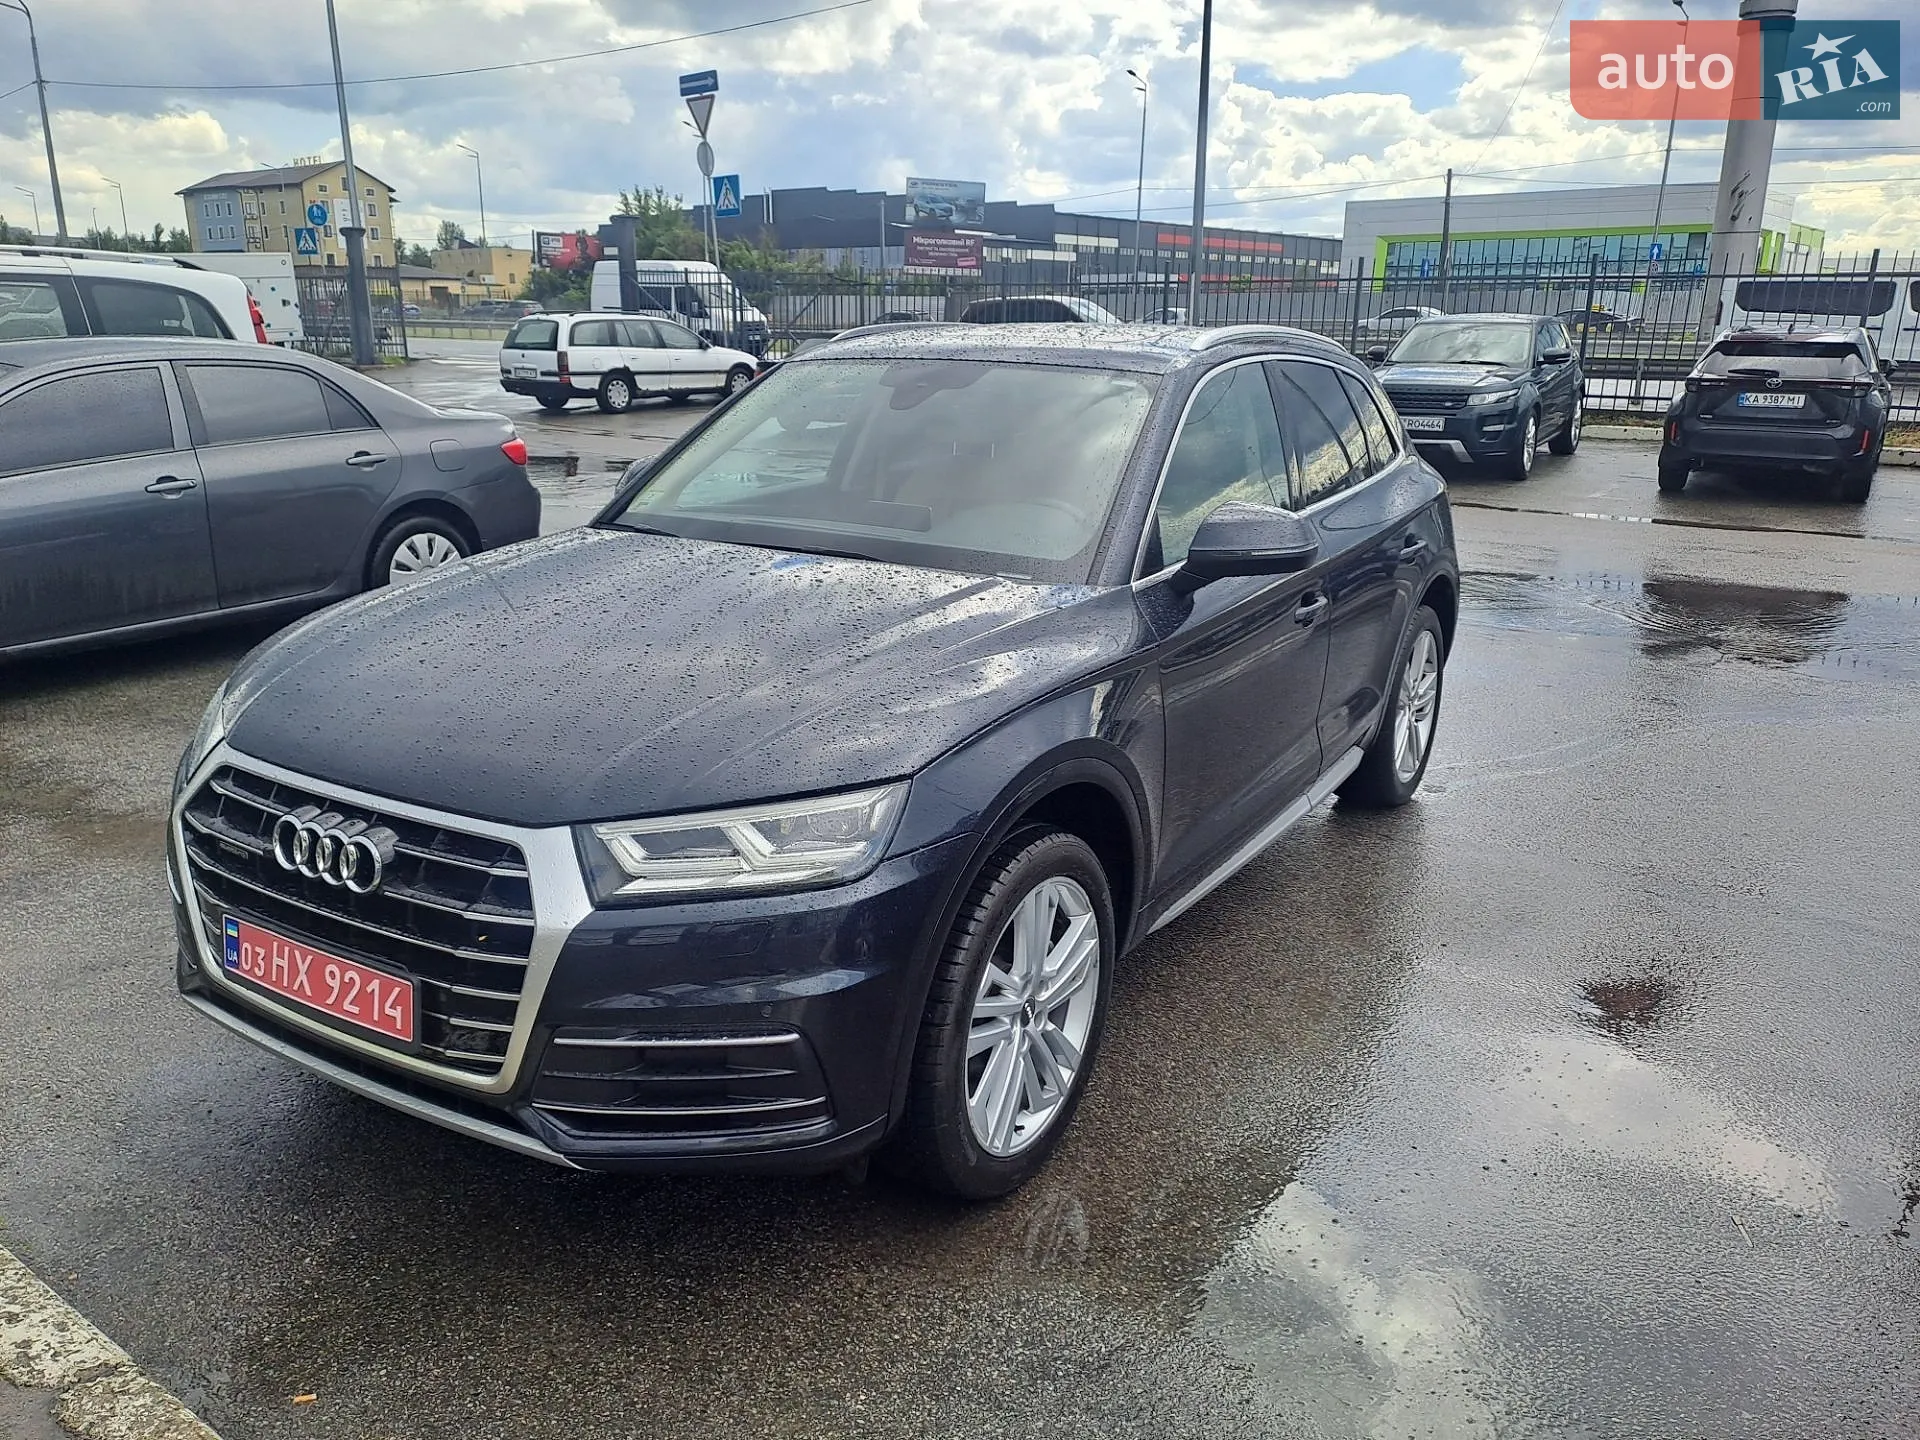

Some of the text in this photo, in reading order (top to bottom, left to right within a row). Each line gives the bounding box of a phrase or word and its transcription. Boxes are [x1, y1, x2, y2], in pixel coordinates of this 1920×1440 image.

[1744, 394, 1801, 404] KA 9387 MI
[227, 947, 239, 964] UA
[240, 941, 404, 1030] 03 HX 9214
